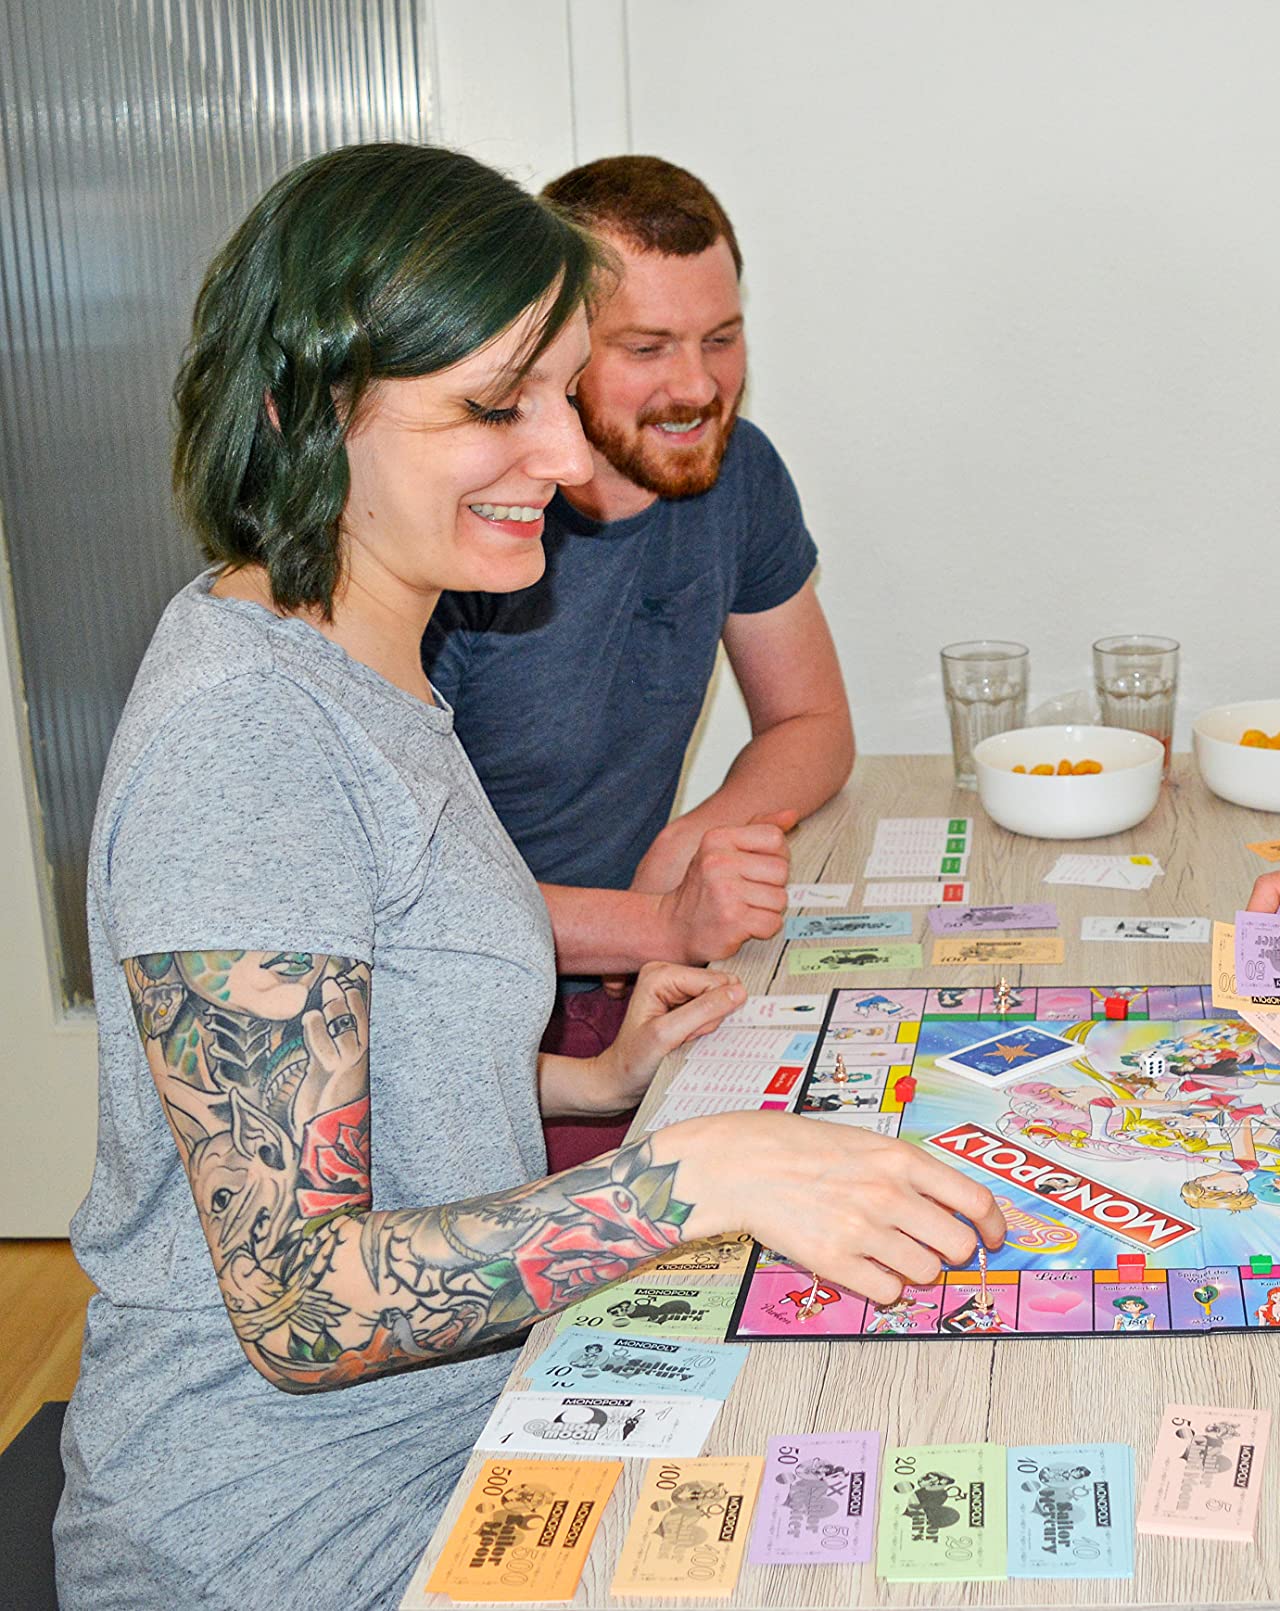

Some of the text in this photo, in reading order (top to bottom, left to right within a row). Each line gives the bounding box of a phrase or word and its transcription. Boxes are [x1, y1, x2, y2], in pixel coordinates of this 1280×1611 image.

[1245, 959, 1265, 981] 50
[941, 1131, 1184, 1242] MONOPOLY
[1035, 1271, 1079, 1281] Liebe
[635, 1288, 700, 1297] MONOPOLY
[575, 1316, 603, 1327] 20
[614, 1338, 680, 1353] MONOPOLY
[545, 1365, 573, 1378] 10
[682, 1354, 716, 1369] 10
[561, 1398, 633, 1407] MONOPOLY
[1172, 1416, 1191, 1427] 5
[500, 1432, 514, 1445] 1
[778, 1446, 800, 1465] 50
[895, 1456, 916, 1475] 20
[1017, 1457, 1038, 1474] 10
[1234, 1445, 1254, 1488] MONOPOLY
[482, 1466, 512, 1497] 500
[656, 1463, 681, 1490] 100
[847, 1472, 865, 1516] MONOPOLY
[969, 1482, 985, 1528] MONOPOLY
[1093, 1481, 1112, 1527] MONOPOLY
[1205, 1498, 1232, 1512] 5
[538, 1500, 569, 1547] MONOPOLY
[563, 1501, 595, 1548] MONOPOLY
[718, 1495, 743, 1542] MONOPOLY
[1038, 1487, 1057, 1554] Mercury
[1057, 1501, 1074, 1547] Sailor
[821, 1525, 849, 1550] 50
[945, 1536, 973, 1561] 20
[1072, 1537, 1100, 1559] 10
[501, 1546, 539, 1586] 500
[688, 1544, 720, 1581] 100
